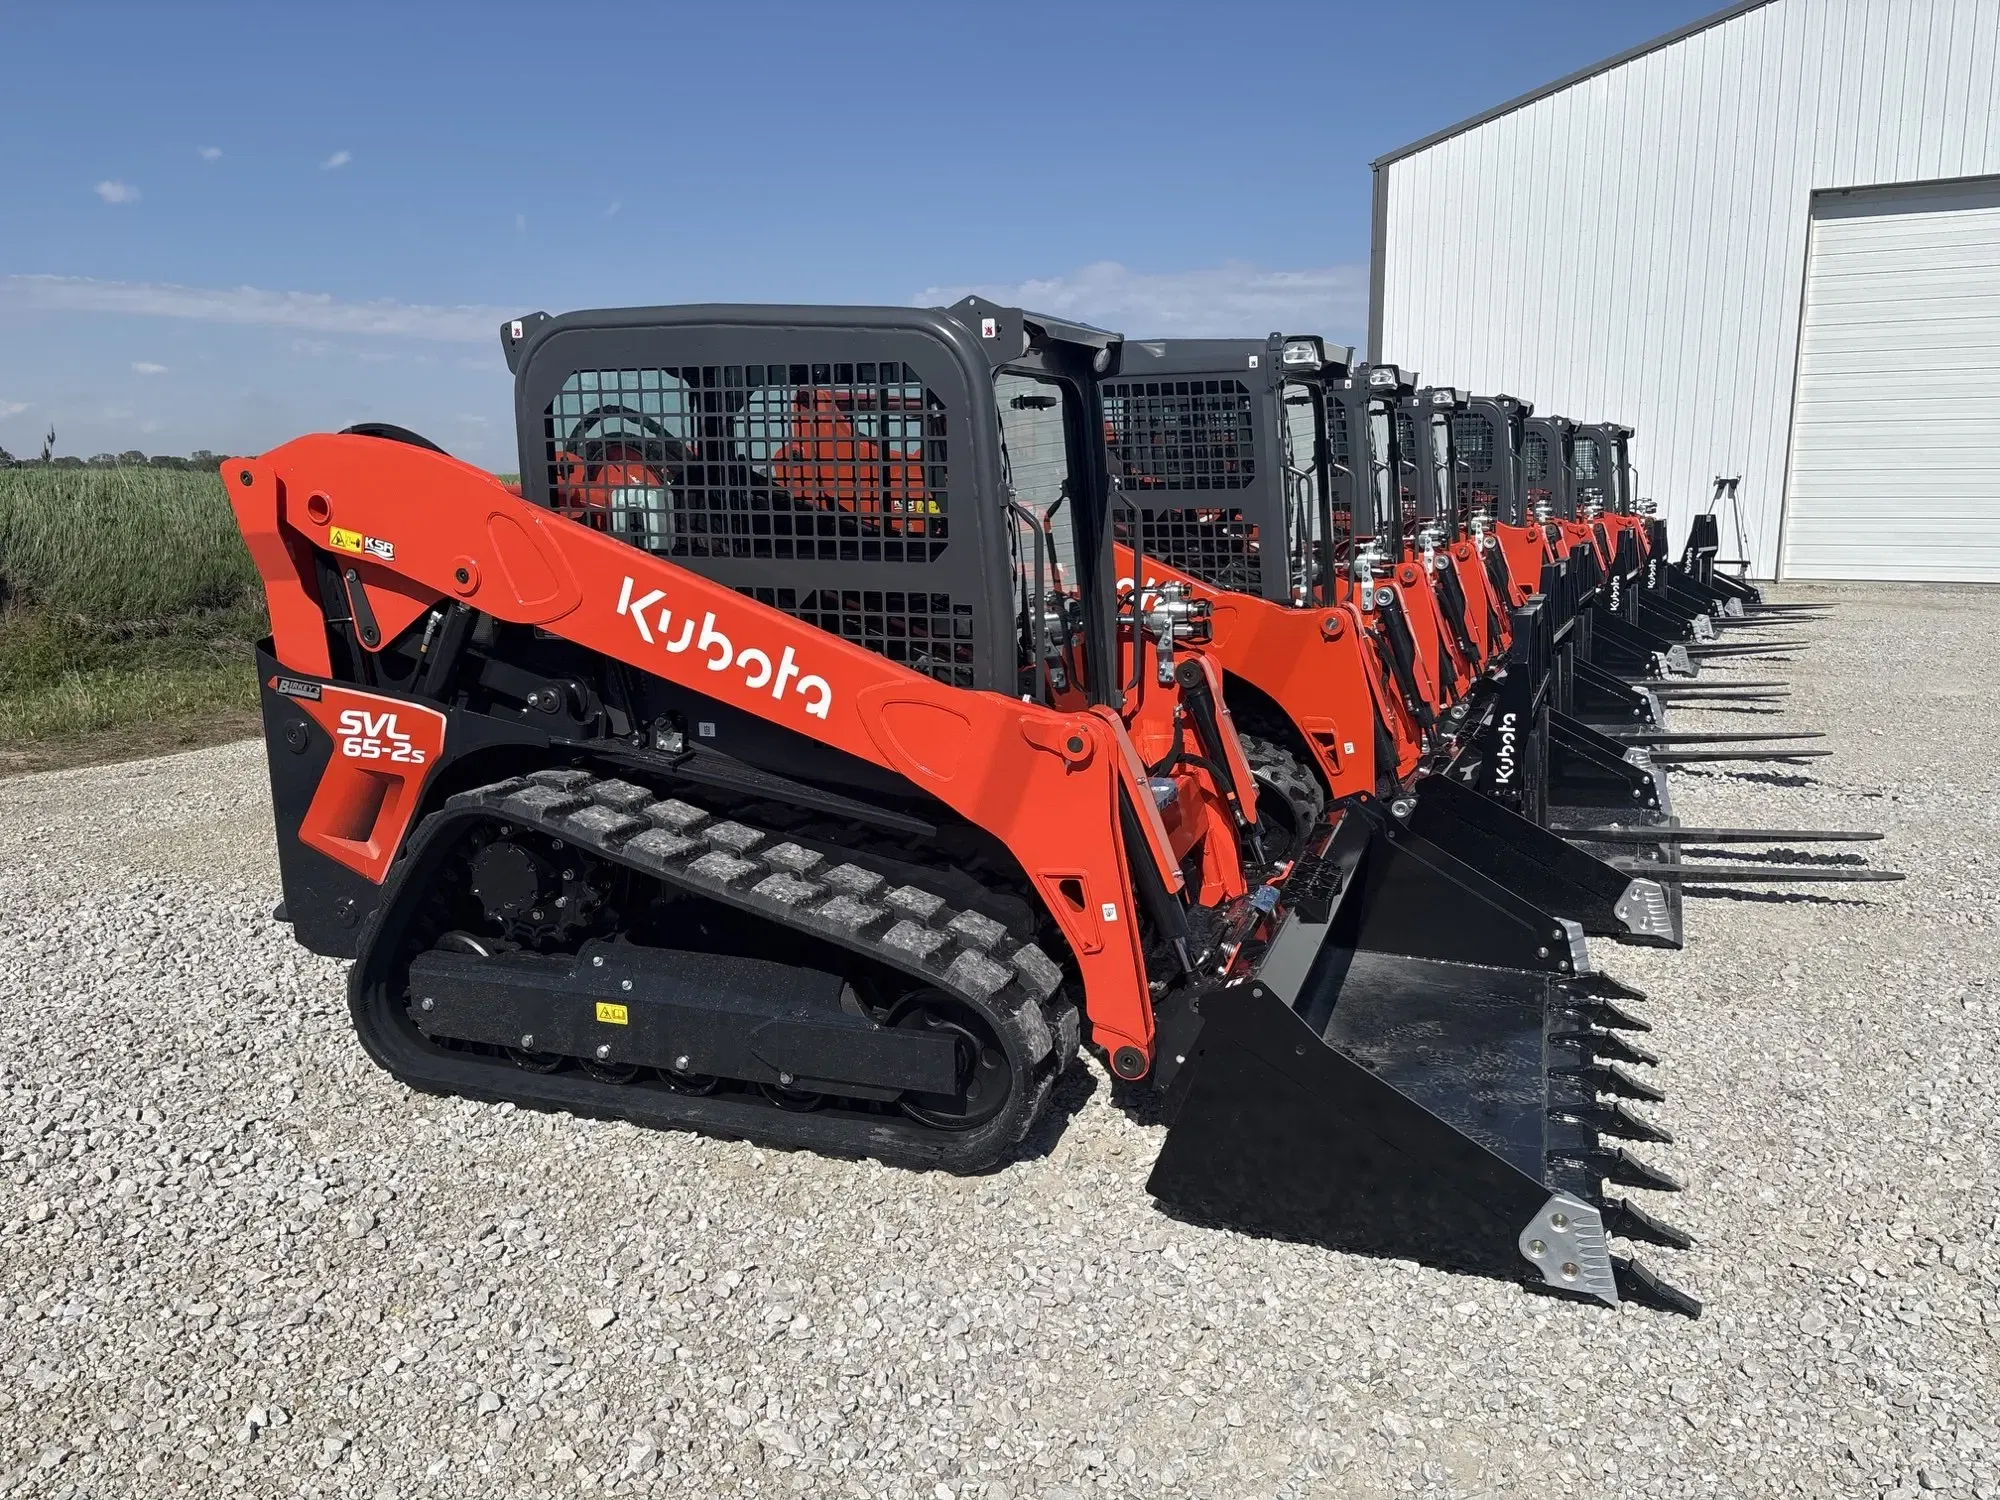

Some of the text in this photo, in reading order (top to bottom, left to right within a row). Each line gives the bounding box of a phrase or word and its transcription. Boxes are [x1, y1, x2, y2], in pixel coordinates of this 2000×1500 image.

[365, 536, 395, 554] KSR
[1648, 558, 1657, 589] Kubota
[1610, 575, 1620, 611] Kubota
[616, 576, 832, 720] Kubota
[336, 709, 411, 741] SVL
[343, 736, 425, 764] 65-2s
[1496, 713, 1517, 783] Kubota
